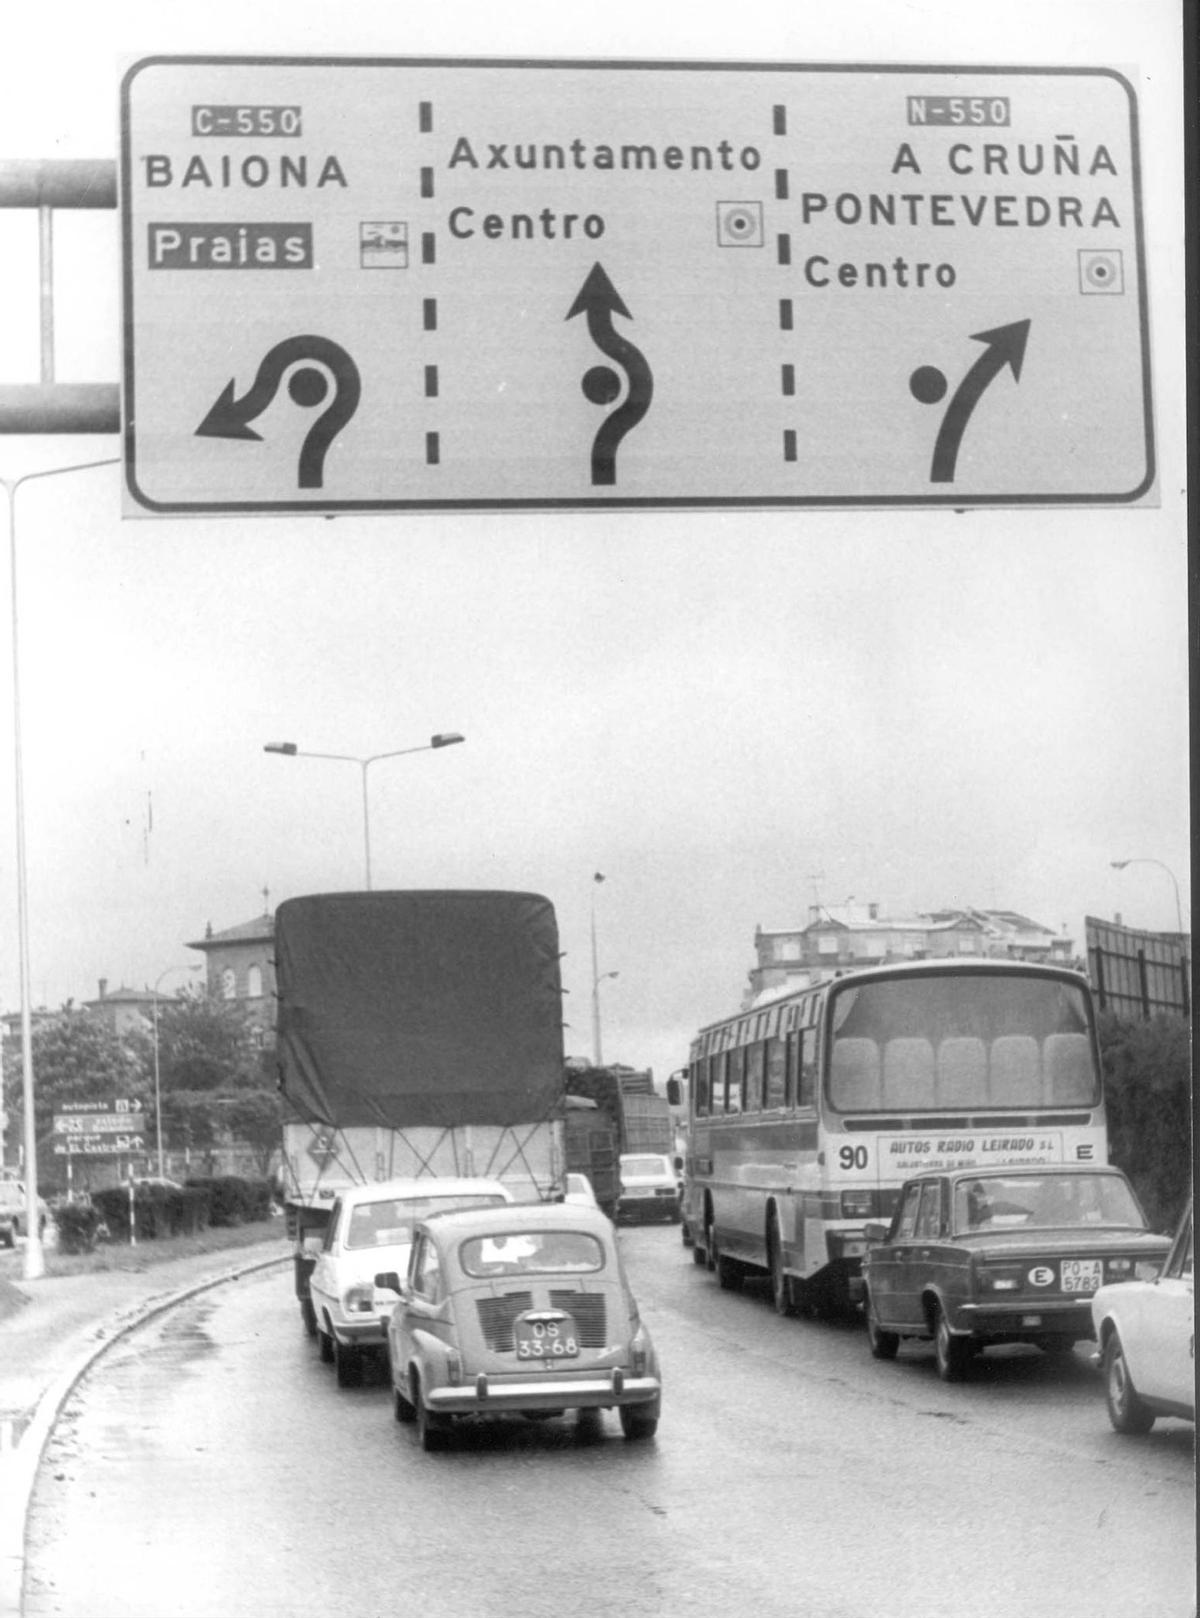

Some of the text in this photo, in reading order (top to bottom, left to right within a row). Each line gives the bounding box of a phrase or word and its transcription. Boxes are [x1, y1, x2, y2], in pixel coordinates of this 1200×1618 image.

[195, 108, 299, 134] C-550
[910, 99, 1007, 124] N-550
[448, 136, 761, 171] Axuntamento
[891, 135, 1118, 176] A CRUÑA
[145, 154, 349, 188] BAIONA
[448, 206, 605, 239] Centro
[801, 192, 1121, 228] PONTEVEDRA
[154, 227, 306, 263] Praias
[804, 255, 956, 288] Centro
[839, 1145, 868, 1170] 90
[890, 1140, 931, 1154] AUTOS
[937, 1140, 975, 1153] RADIO
[982, 1138, 1034, 1152] LEIRADO
[1076, 1144, 1094, 1160] E
[1034, 1269, 1049, 1284] E
[519, 1337, 577, 1357] 33-68
